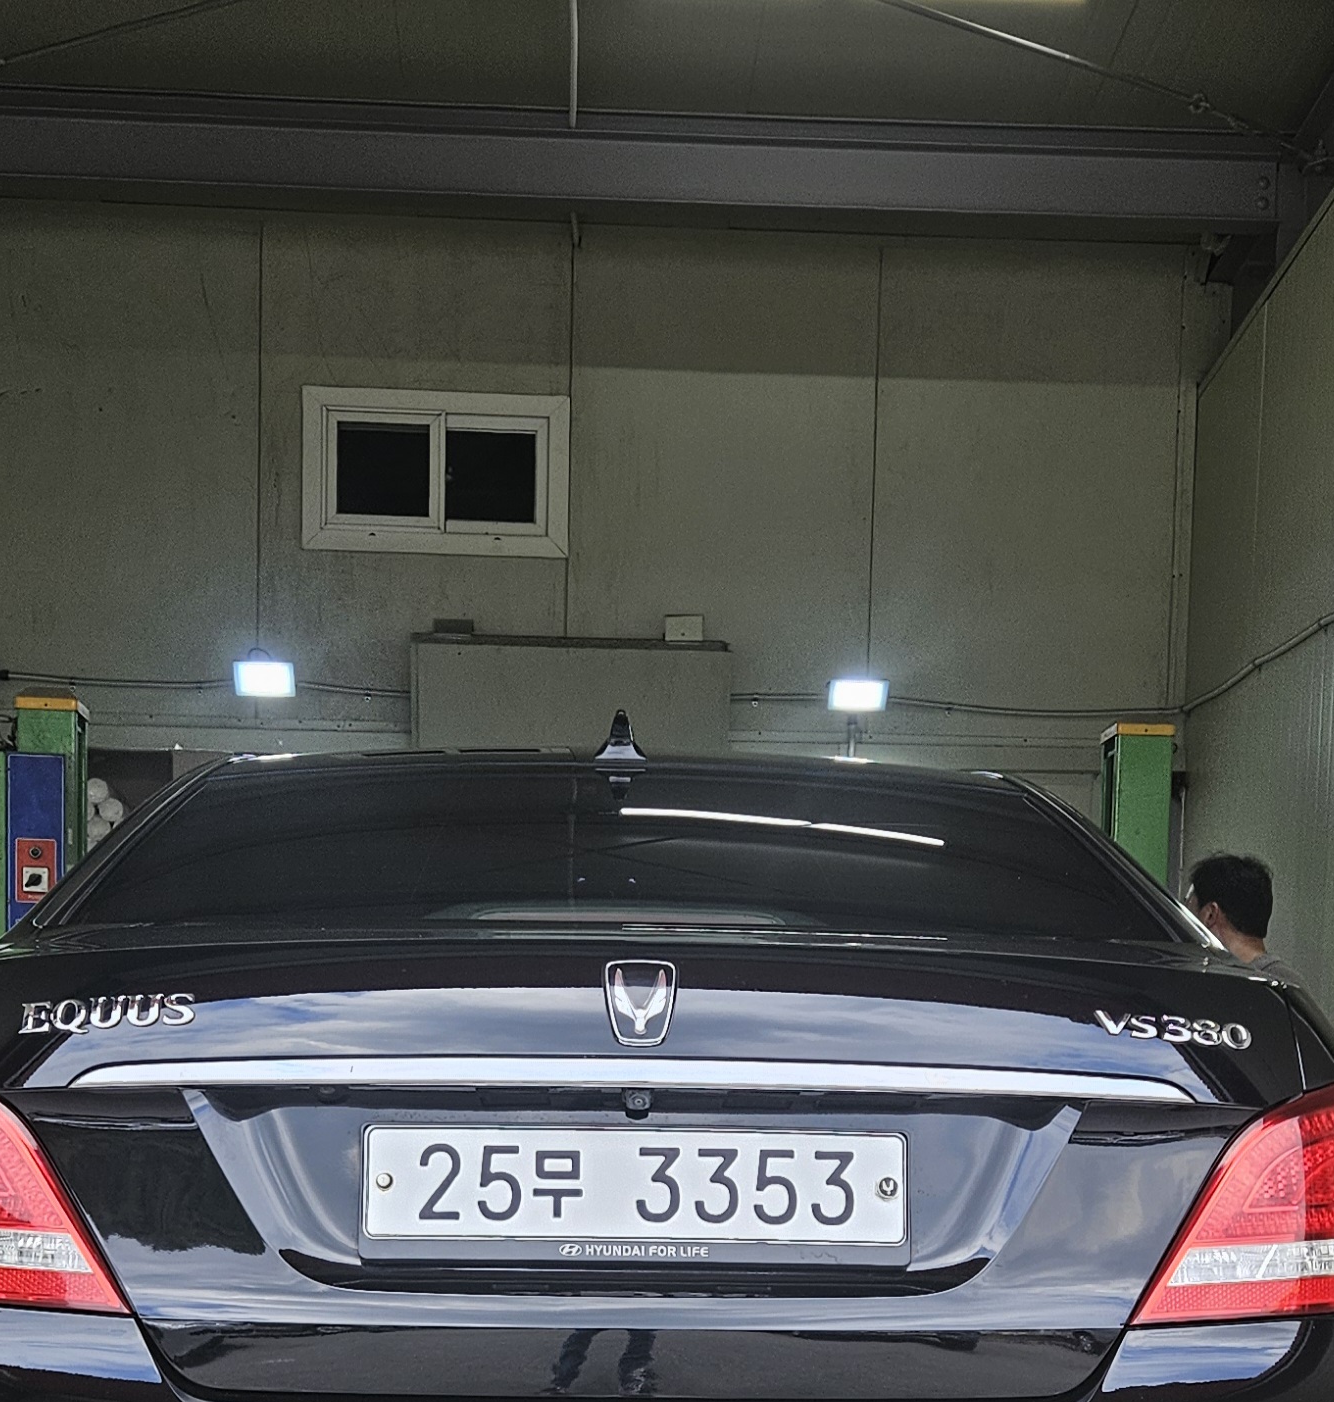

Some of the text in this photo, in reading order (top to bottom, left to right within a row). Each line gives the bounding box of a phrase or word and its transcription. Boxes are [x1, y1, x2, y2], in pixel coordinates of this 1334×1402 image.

[18, 993, 195, 1034] EQUUS
[1093, 1010, 1252, 1050] VS380
[418, 1143, 855, 1226] 25무 3353
[585, 1244, 709, 1257] HYUNDAI FOR LIFE
